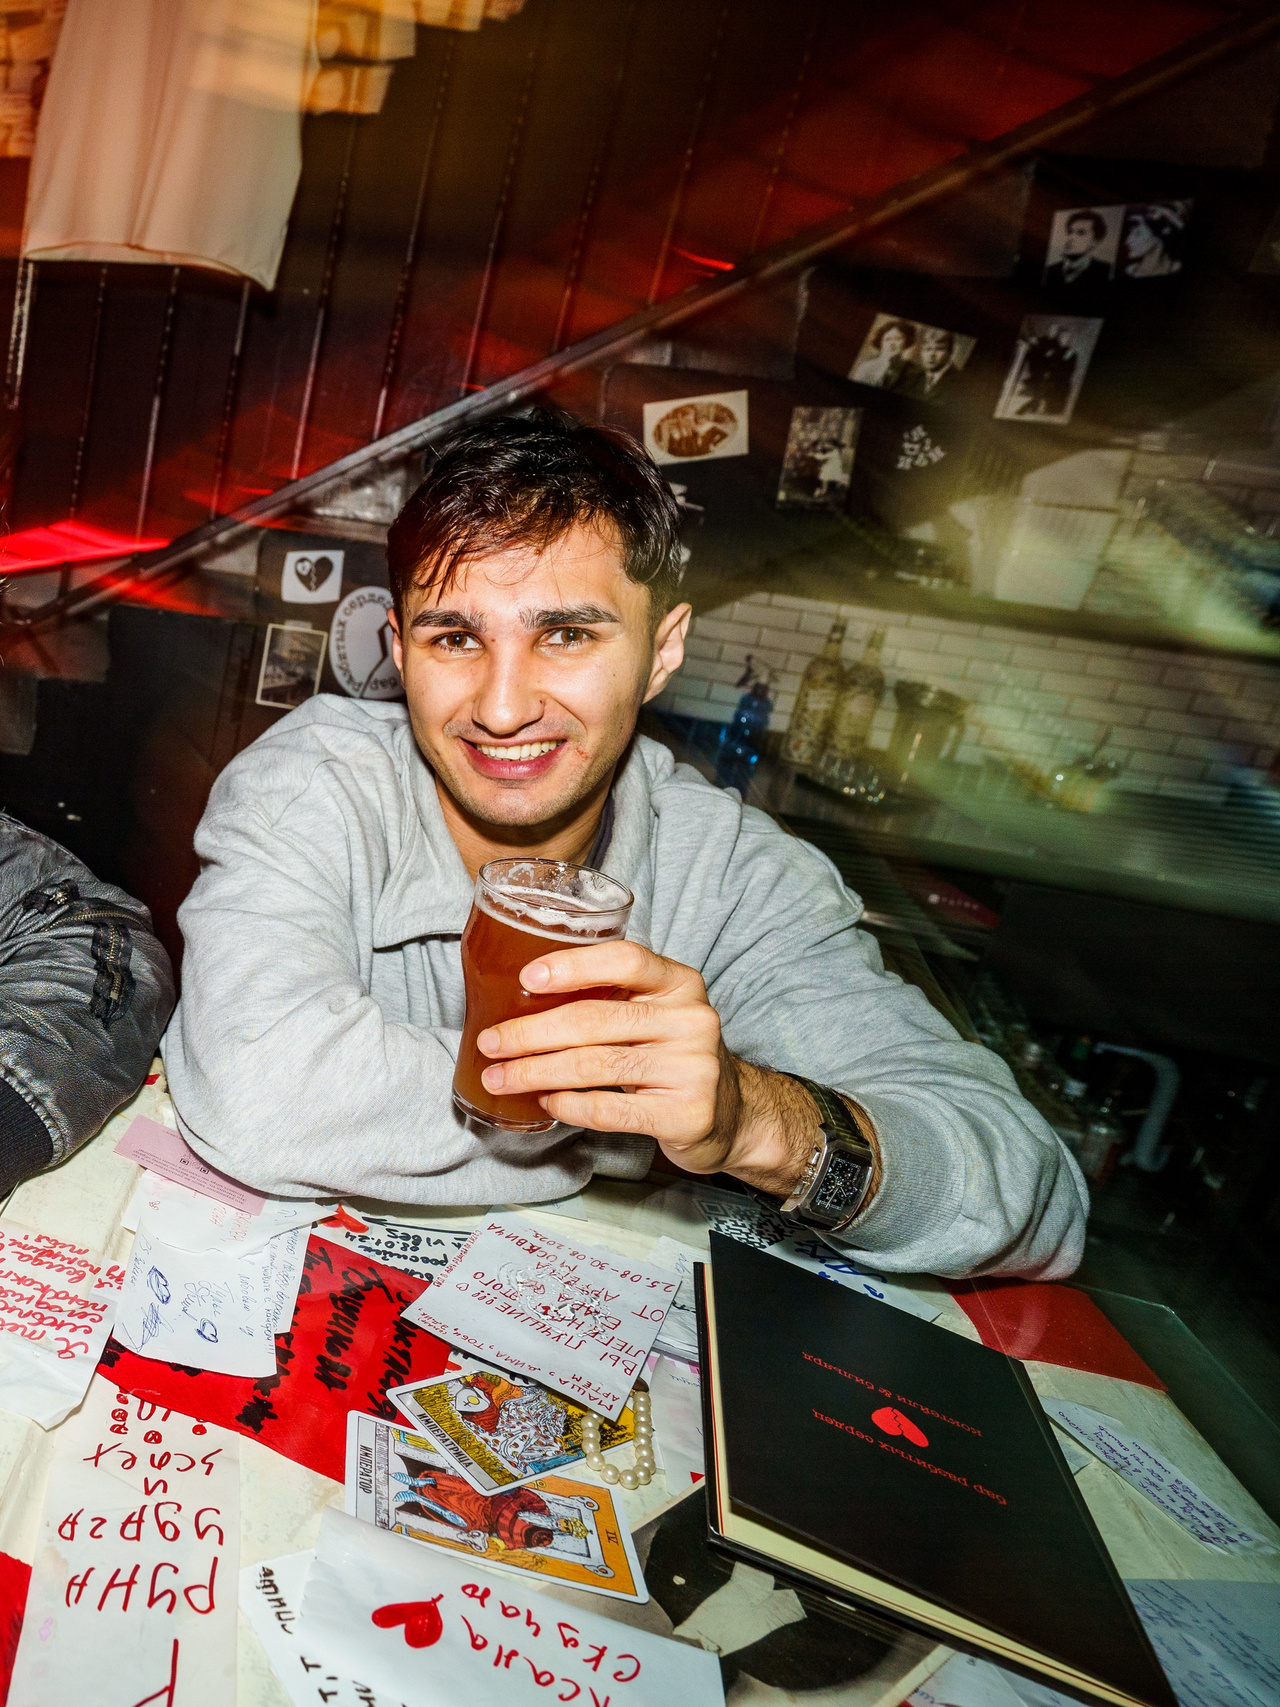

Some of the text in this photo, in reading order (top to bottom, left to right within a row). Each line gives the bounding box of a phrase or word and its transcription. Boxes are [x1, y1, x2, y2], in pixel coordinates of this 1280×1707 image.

[54, 1339, 88, 1357] Я
[802, 1351, 983, 1437] коктейли & бильярд
[417, 1413, 473, 1467] ИМПЕРАТРИЦА
[813, 1409, 1007, 1506] бар разбитых сердец
[359, 1444, 373, 1494] ИМПЕРАТОР
